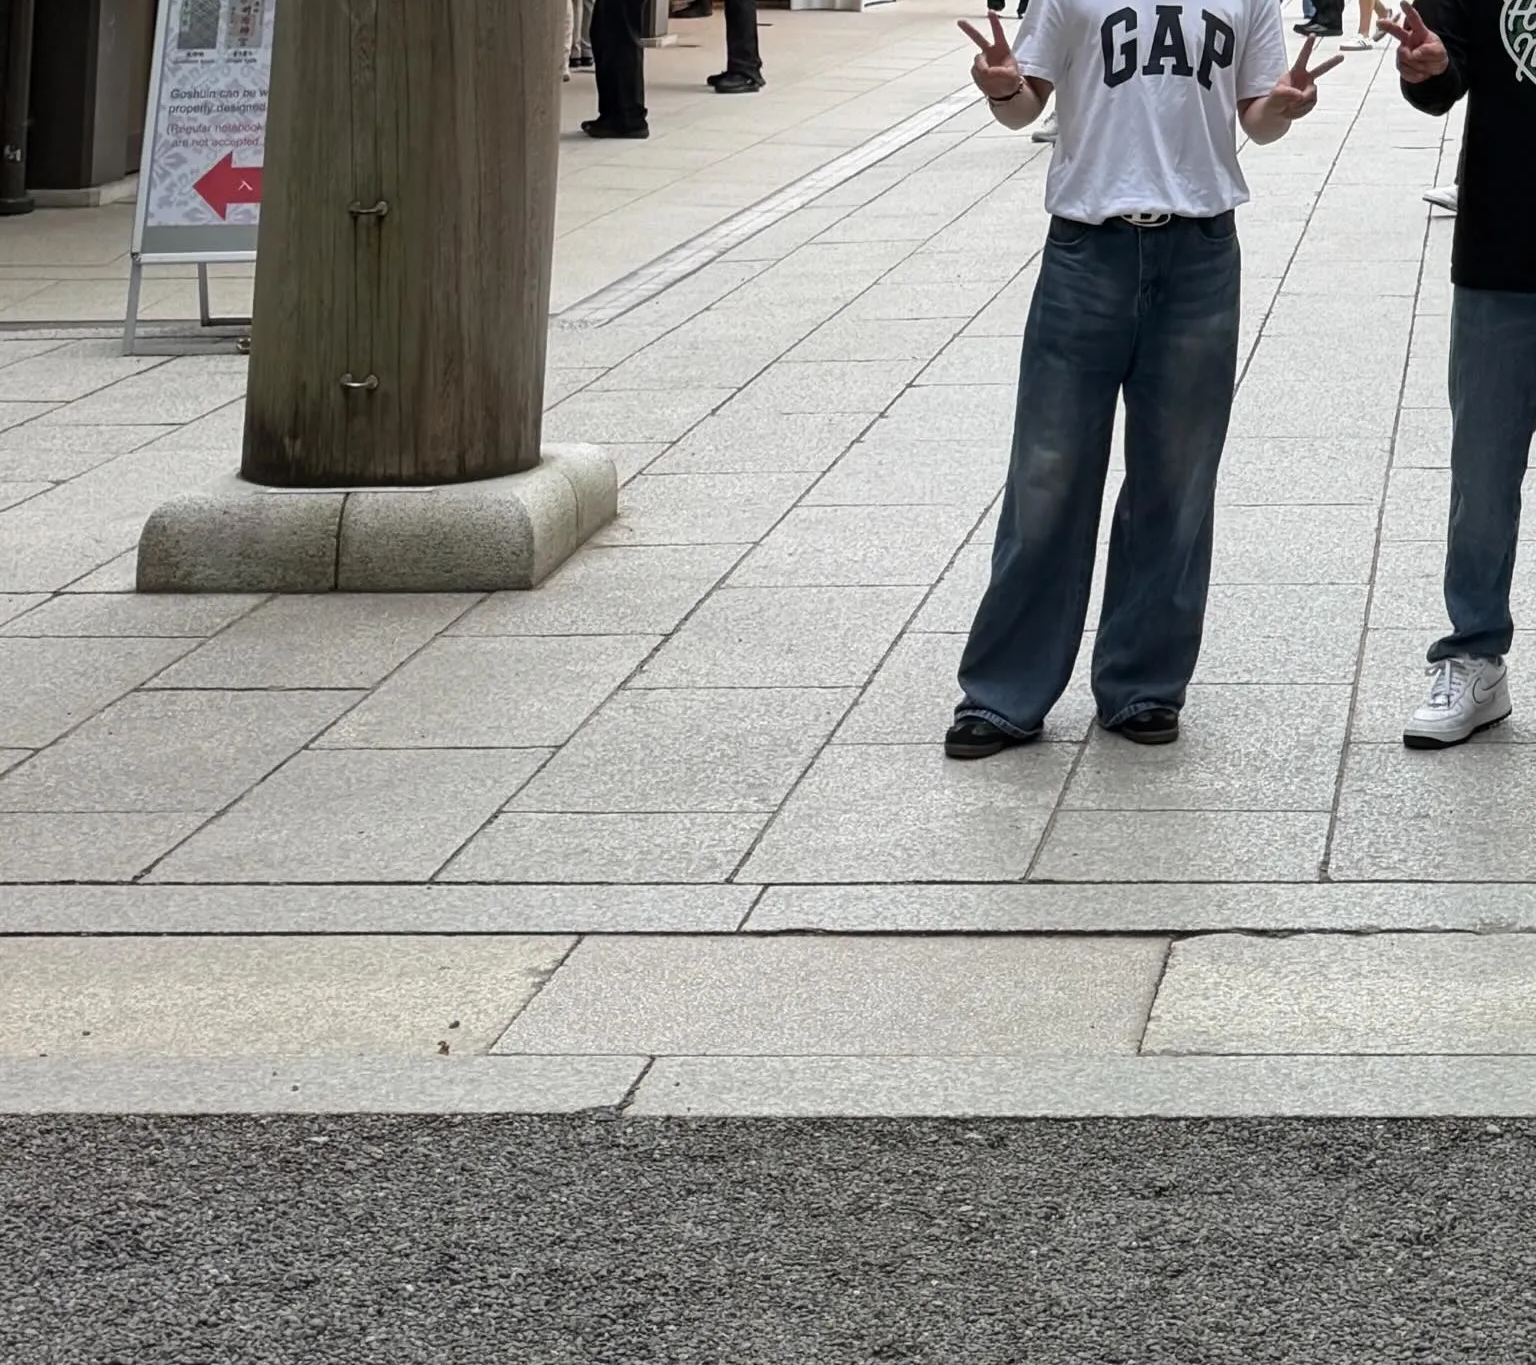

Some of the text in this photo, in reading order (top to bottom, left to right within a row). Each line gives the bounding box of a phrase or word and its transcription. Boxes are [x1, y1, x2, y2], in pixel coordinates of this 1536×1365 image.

[1100, 4, 1236, 92] GAP
[170, 88, 216, 99] Goshuin
[219, 90, 240, 99] can
[216, 101, 266, 114] designed
[171, 138, 189, 148] are
[191, 137, 209, 146] not
